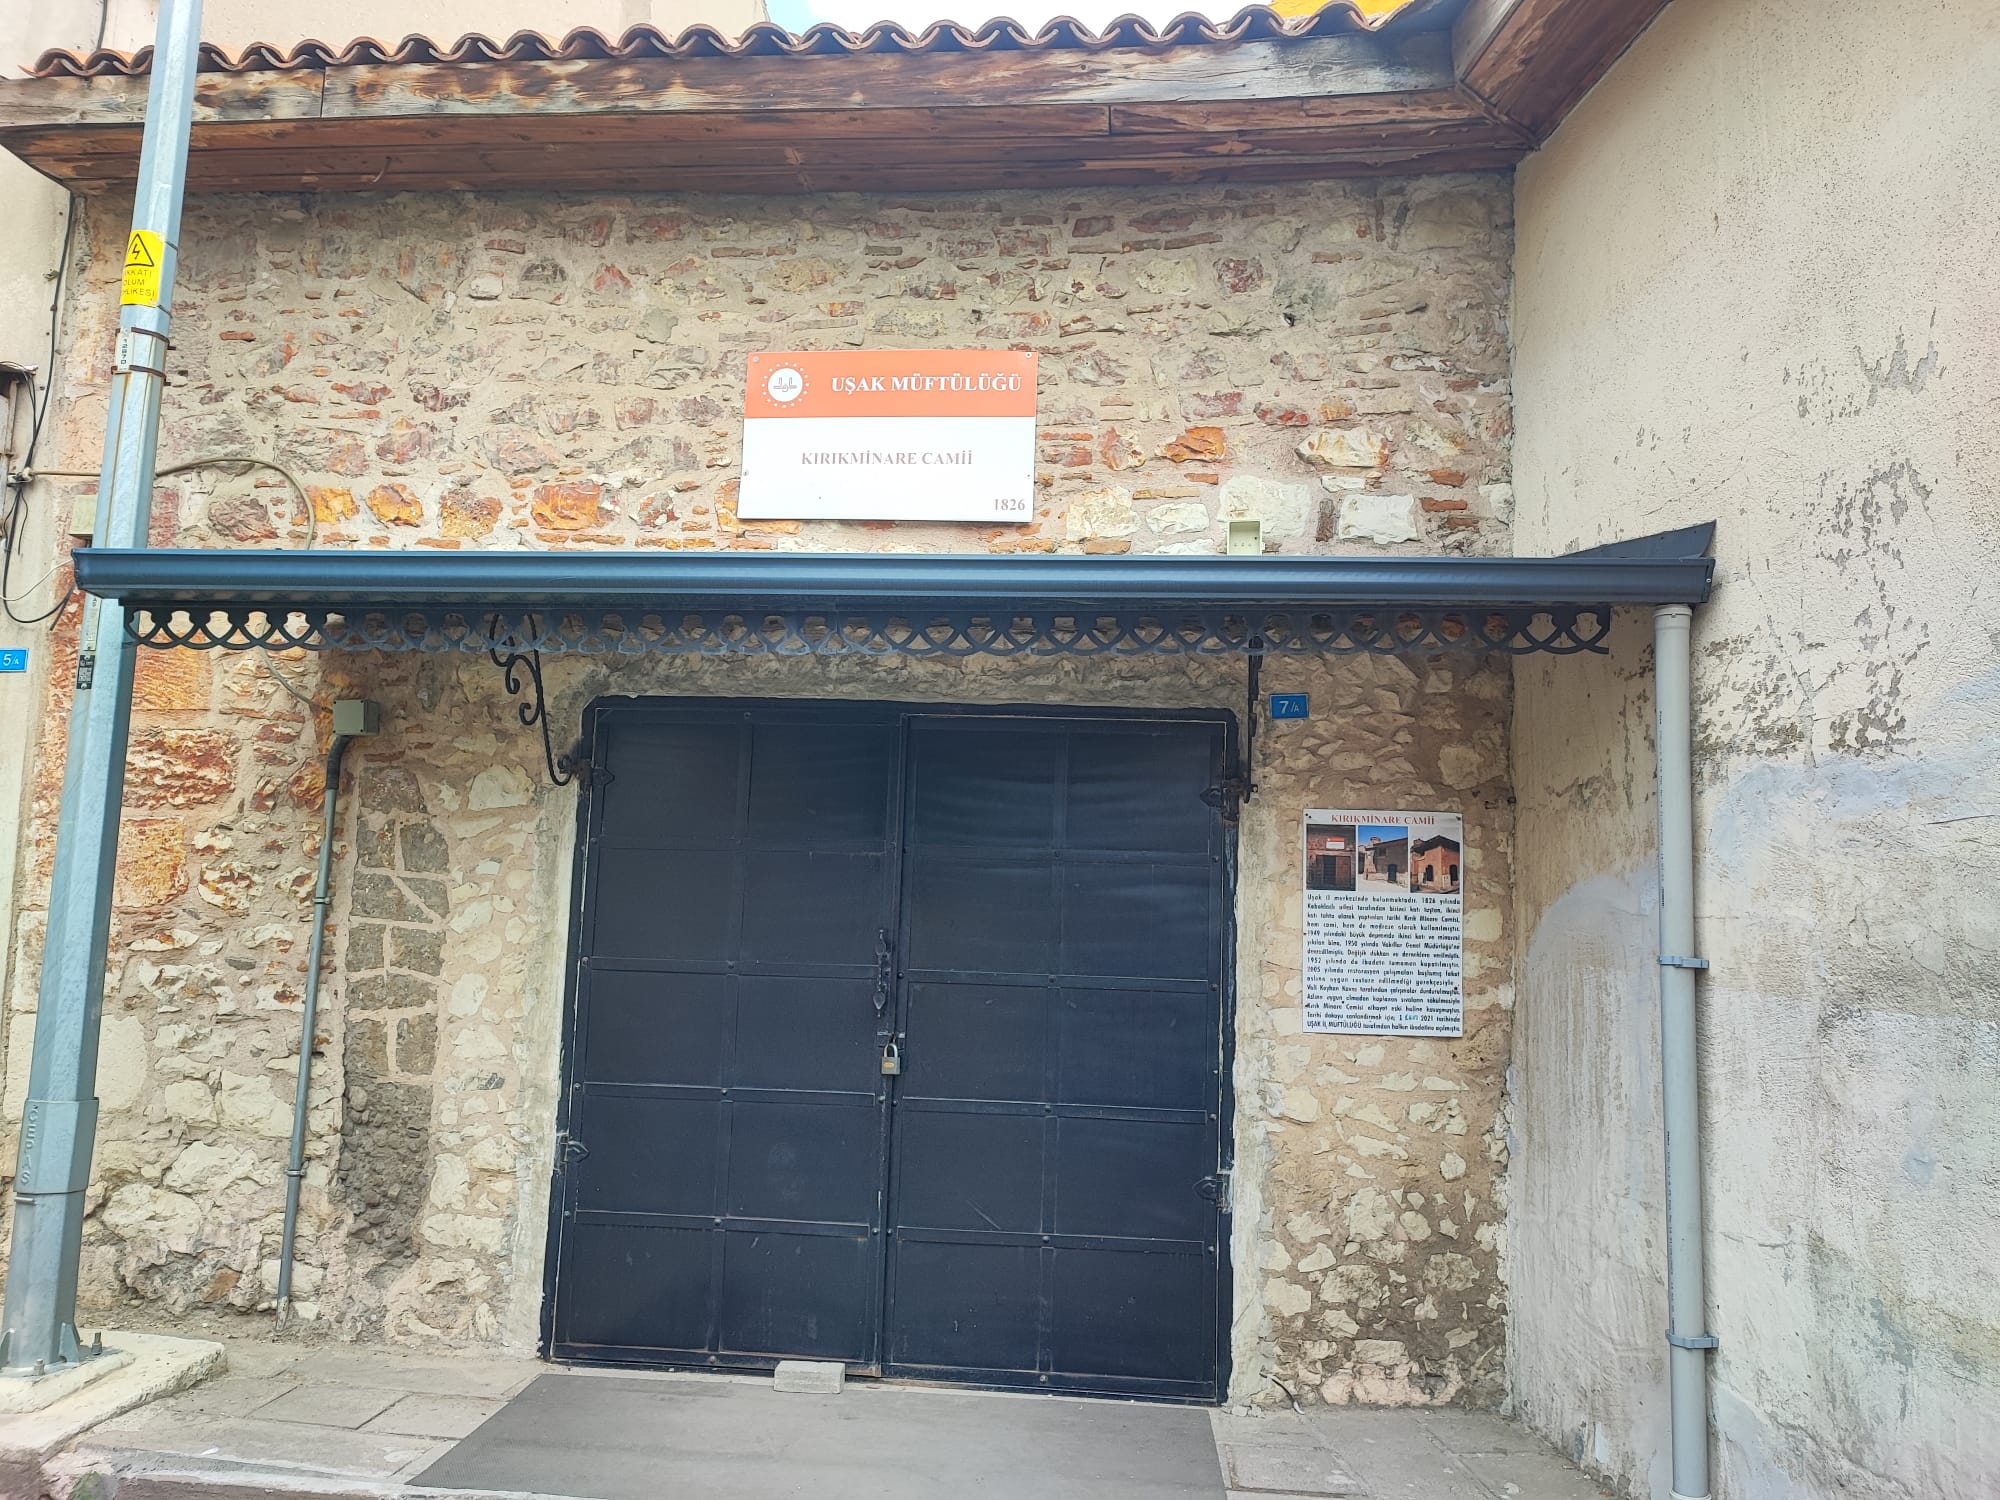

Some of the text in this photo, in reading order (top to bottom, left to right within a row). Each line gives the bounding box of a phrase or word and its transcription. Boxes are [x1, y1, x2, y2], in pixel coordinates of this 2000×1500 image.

[831, 372, 1023, 395] UŞAK MÜFTÜLÜĞÜ
[801, 449, 973, 465] KIRIKMİNARE CAMİİ
[994, 498, 1026, 511] 1826
[1279, 700, 1300, 715] 7/A
